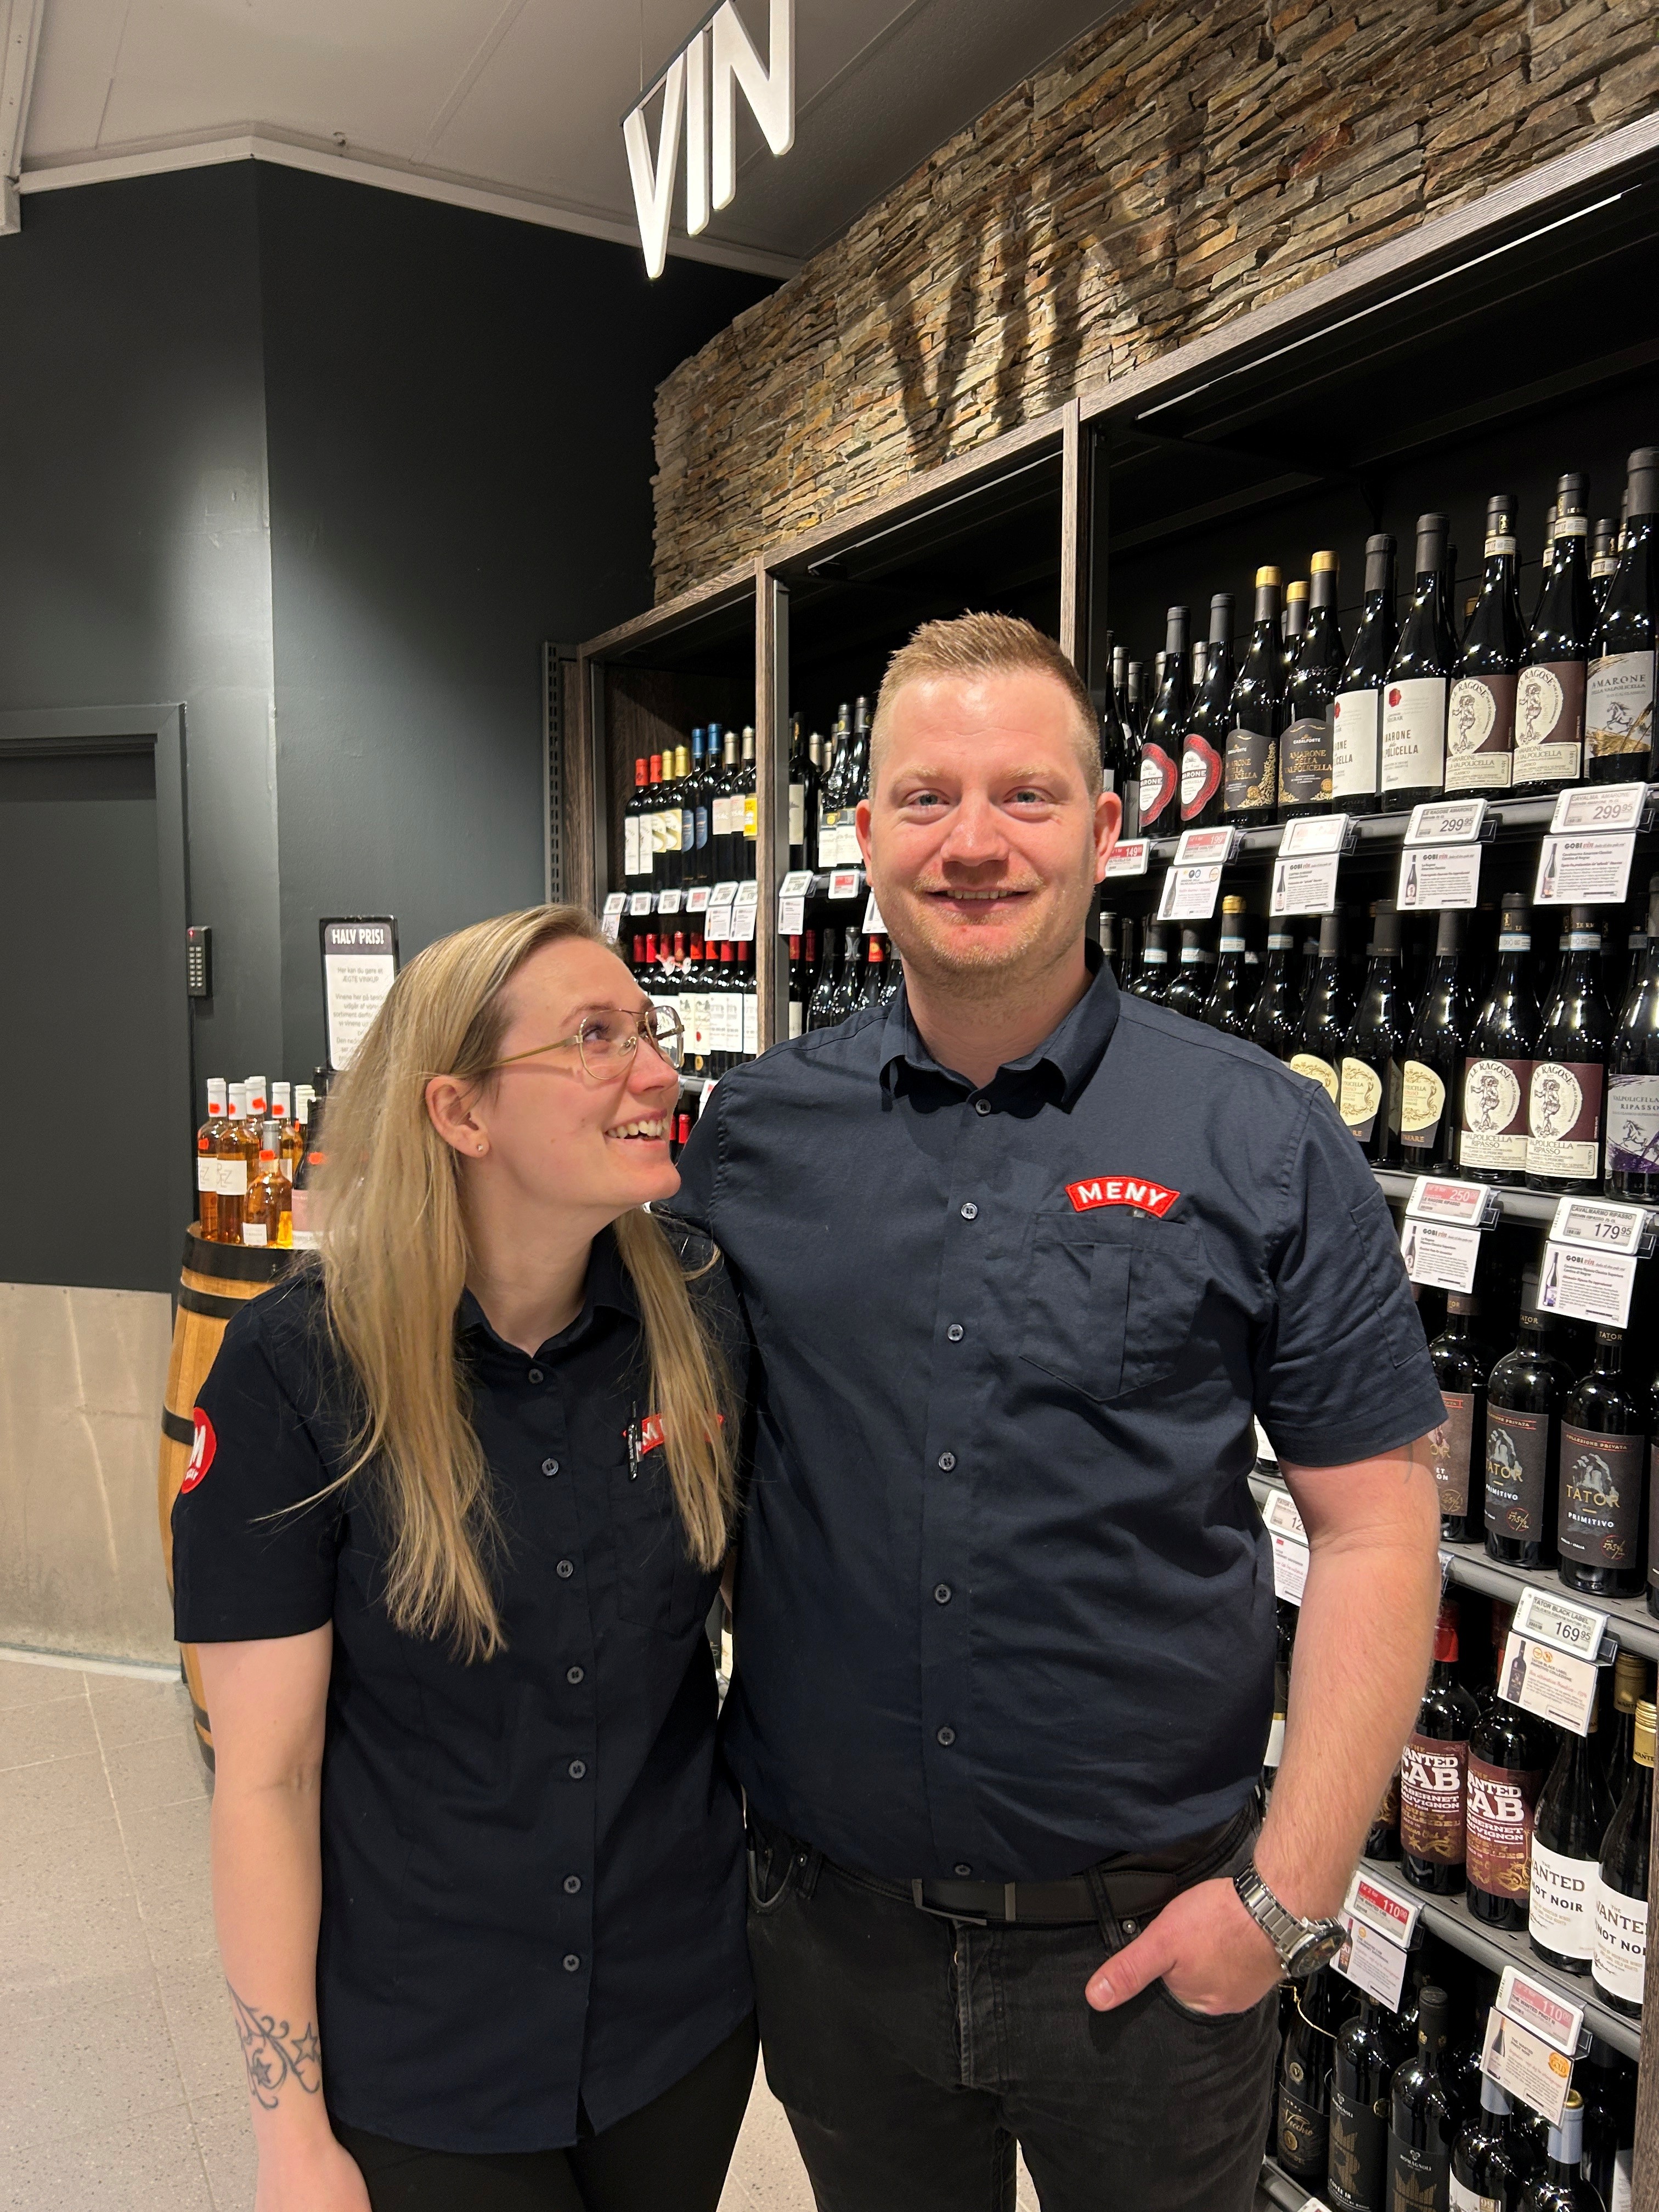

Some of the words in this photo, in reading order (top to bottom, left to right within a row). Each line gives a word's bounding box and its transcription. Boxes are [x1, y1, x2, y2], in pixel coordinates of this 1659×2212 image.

[623, 0, 795, 279] VIN
[1525, 669, 1553, 686] RAGOSE
[1592, 674, 1646, 689] AMARONE
[1458, 681, 1489, 698] RAGOSE
[1385, 730, 1411, 742] MARONE
[1290, 750, 1327, 759] AMARONE
[1384, 745, 1419, 758] POLICELLA
[1295, 757, 1318, 765] DELLA
[1182, 770, 1206, 779] ARONE
[1141, 778, 1163, 787] ARONE
[332, 929, 356, 944] HALV
[359, 929, 384, 944] PRIS!
[1479, 1062, 1514, 1081] RAGOSE
[1542, 1065, 1575, 1085] RAGOSE
[1533, 1147, 1561, 1155] RIPASSO
[1077, 1182, 1168, 1206] MENY
[1571, 1206, 1608, 1216] CAVALMARMO
[1609, 1211, 1633, 1220] RIPASSO
[1520, 1315, 1538, 1324] ATOR
[1599, 1331, 1623, 1340] TATOR
[1505, 1419, 1530, 1427] PRIVATA
[1566, 1485, 1620, 1508] TATOR
[1568, 1512, 1614, 1528] PRIMITIVO
[1534, 1598, 1551, 1609] TATOR
[1551, 1605, 1570, 1617] BLACK
[1571, 1613, 1589, 1624] LABEL
[1635, 1750, 1655, 1762] WANTE
[1542, 1860, 1550, 1870] THE
[1532, 1882, 1547, 1899] NOT
[1550, 1894, 1584, 1912] NOIR
[1384, 1899, 1401, 1917] 110
[1610, 1905, 1622, 1914] THE
[1596, 1900, 1647, 1936] ANTE
[1621, 1939, 1646, 1956] NOI
[1520, 1999, 1538, 2013] WANTED
[1538, 2011, 1551, 2022] PINOT
[1543, 2001, 1562, 2021] 110
[1400, 2154, 1432, 2171] ROMAGNOLI
